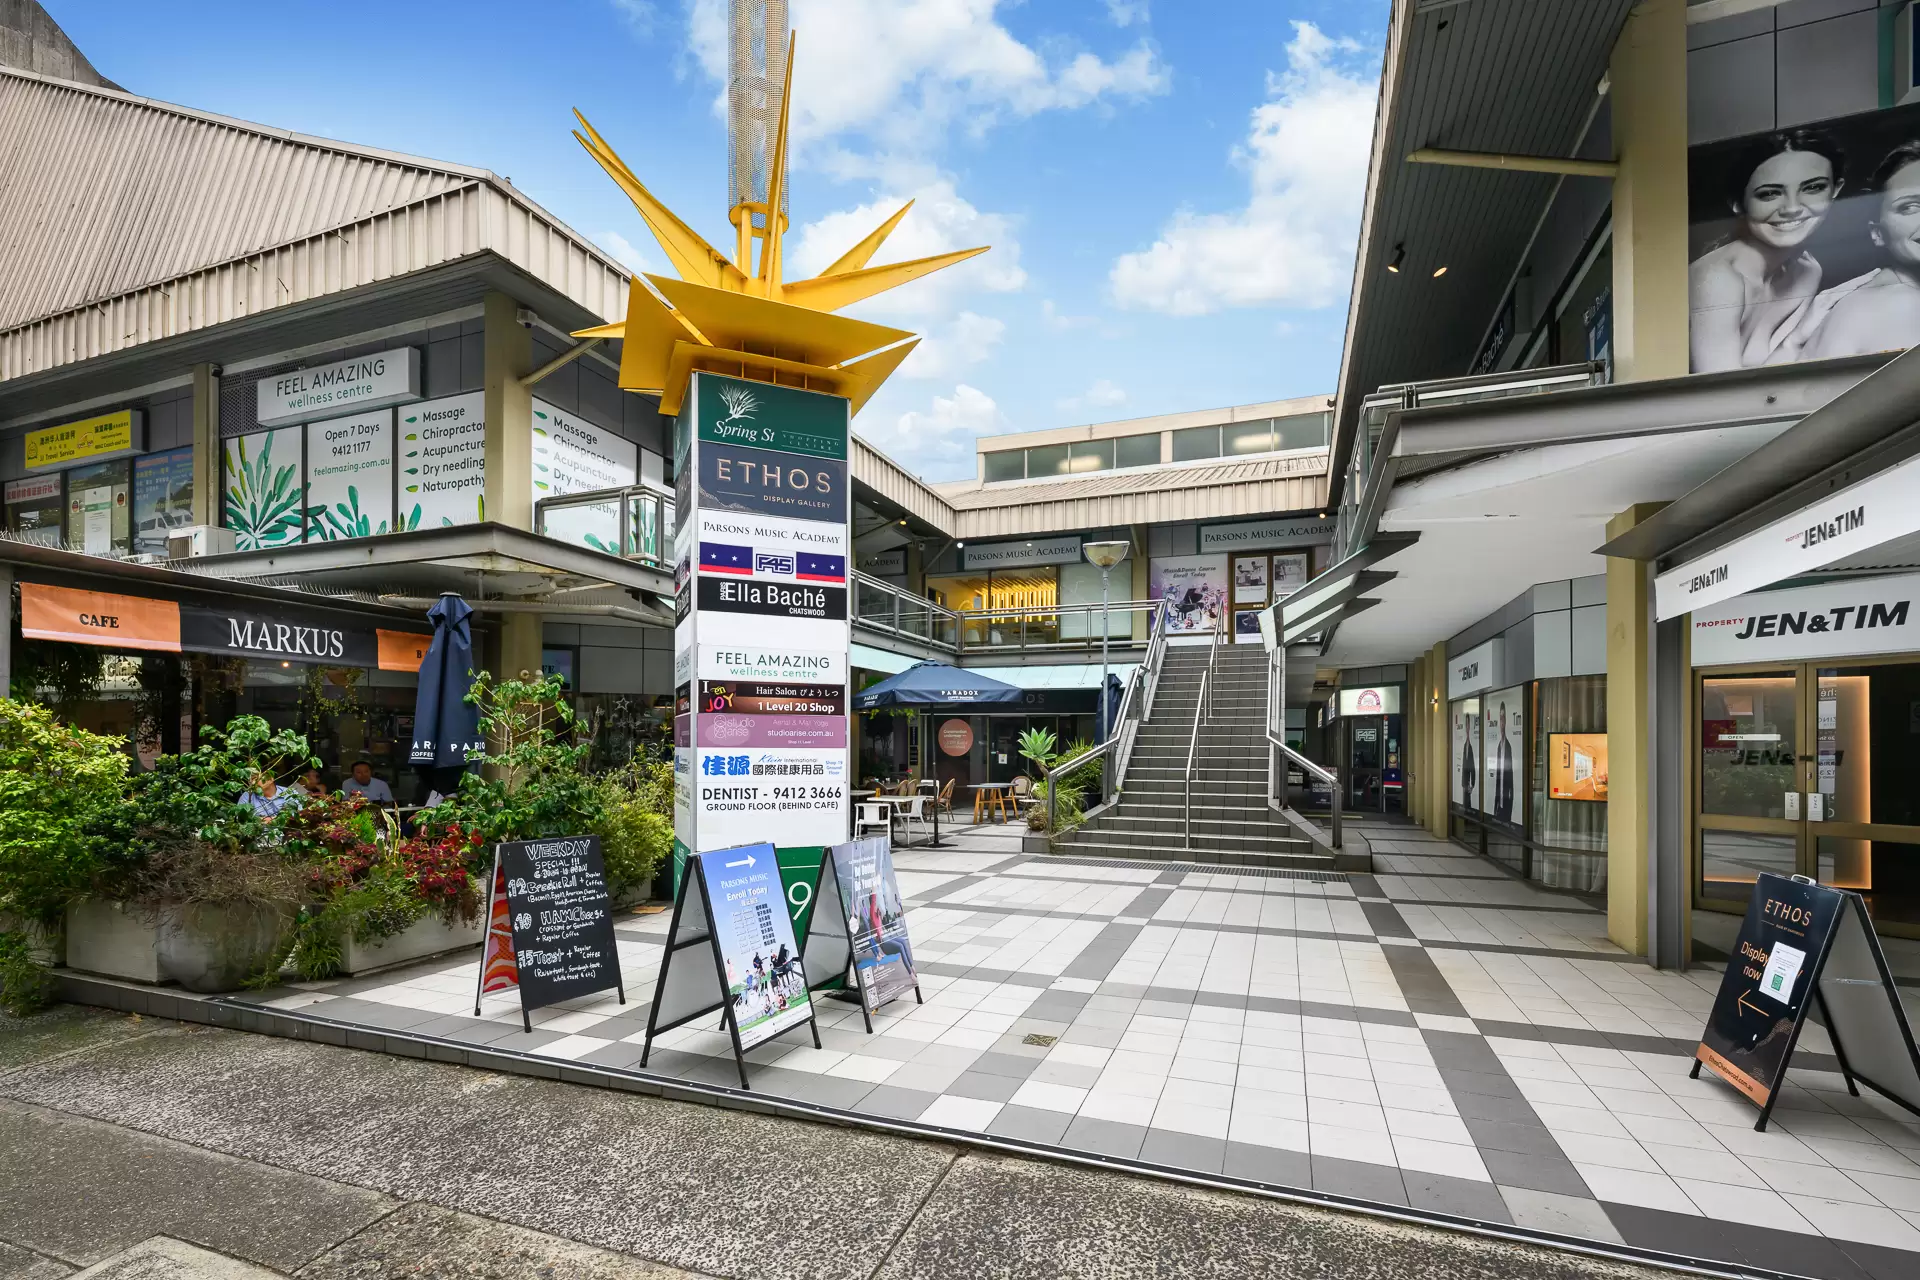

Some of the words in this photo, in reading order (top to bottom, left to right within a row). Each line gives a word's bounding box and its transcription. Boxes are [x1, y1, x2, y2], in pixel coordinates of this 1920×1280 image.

[277, 376, 307, 397] FEEL
[312, 359, 385, 388] AMAZING
[288, 389, 332, 409] wellness
[336, 384, 372, 400] centre
[423, 408, 465, 423] Massage
[325, 430, 348, 442] Open
[351, 426, 356, 437] 7
[358, 423, 380, 438] Days
[554, 416, 598, 444] Massage
[714, 420, 758, 442] Spring
[761, 428, 775, 442] St
[60, 449, 75, 457] Service
[332, 444, 351, 456] 9412
[353, 441, 370, 454] 1177
[422, 440, 485, 458] Acupuncture
[554, 434, 616, 467] Chiropractor
[314, 458, 390, 476] feelamazing.com.au
[423, 463, 439, 477] Dry
[443, 457, 485, 474] needling
[554, 452, 616, 484] Acupuncture
[716, 458, 831, 493] ETHOS
[423, 475, 485, 492] Naturopathy
[554, 468, 572, 485] Dry
[764, 494, 795, 505] DISPLAY
[798, 499, 831, 509] GALLERY
[704, 522, 750, 535] PARSONS
[754, 527, 788, 539] MUSIC
[792, 531, 841, 544] ACADEMY
[1205, 532, 1248, 543] PARSONS
[1251, 529, 1284, 539] MUSIC
[1785, 532, 1804, 543] PROPERTY
[1801, 506, 1864, 550] JEN&TIM
[864, 558, 900, 567] ACADEMY
[968, 552, 1003, 562] PARSONS
[1006, 549, 1033, 558] MUSIC
[1036, 546, 1078, 556] ACADEMY
[757, 554, 793, 573] F45
[1689, 564, 1728, 594] JEN&TIM
[726, 582, 761, 603] Ella
[767, 585, 825, 608] Baché
[79, 613, 120, 628] CAFE
[789, 608, 825, 616] CHATSWOOD
[1696, 617, 1744, 628] PROPERTY
[1735, 600, 1910, 640] JEN&TIM
[228, 618, 344, 658] MARKUS
[716, 652, 751, 665] FEEL
[757, 655, 830, 668] AMAZING
[730, 667, 778, 677] wellness
[782, 669, 818, 678] centre
[702, 681, 710, 694] I
[706, 693, 734, 712] JOY
[756, 687, 774, 695] Hair
[775, 687, 797, 696] Salon
[758, 702, 763, 710] 1
[767, 702, 792, 711] Level
[795, 703, 807, 712] 20
[810, 703, 835, 714] Shop
[702, 755, 750, 776] 佳源
[752, 764, 824, 776] 國際健康用品
[702, 788, 758, 800] DENTIST
[773, 787, 806, 799] 9412
[810, 787, 841, 798] 3666
[778, 802, 812, 811] (BEHIND
[525, 839, 590, 860] WEEKDAY
[535, 860, 570, 869] SPECIAL
[721, 877, 748, 889] PARSONS
[750, 873, 768, 884] MUSIC
[727, 890, 747, 901] Enroll
[748, 886, 768, 896] Today
[1764, 898, 1812, 927] ETHOS
[1741, 941, 1770, 967] Display
[1743, 965, 1762, 980] now
